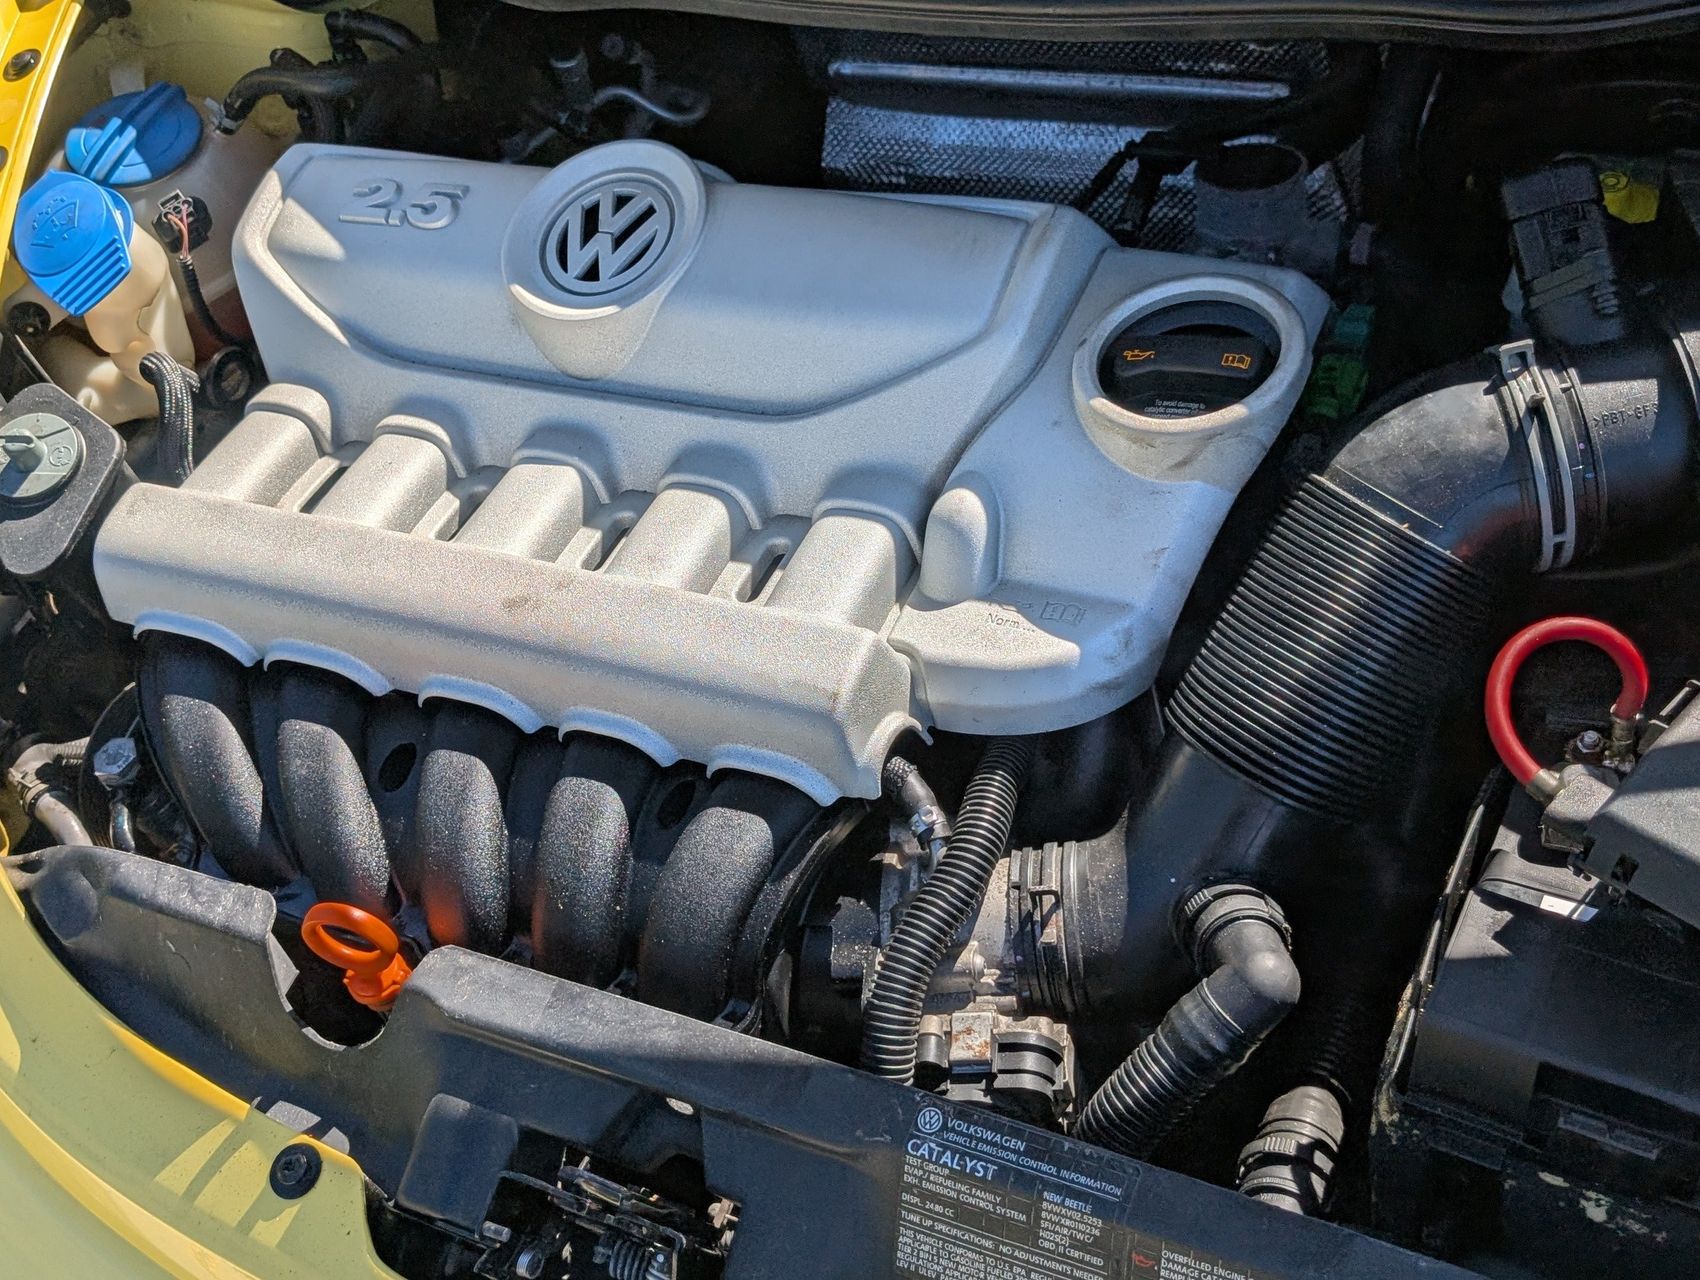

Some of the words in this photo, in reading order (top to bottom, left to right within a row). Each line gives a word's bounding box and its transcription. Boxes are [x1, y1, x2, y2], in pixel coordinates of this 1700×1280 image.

[338, 177, 471, 230] 2.5
[1178, 401, 1200, 409] damage
[947, 1118, 1026, 1152] VOLKSWAGEN
[905, 1155, 922, 1167] TEST
[923, 1161, 950, 1176] GROUP
[907, 1139, 998, 1180] CATALYST
[943, 1131, 977, 1148] VEHICLE
[977, 1142, 1018, 1162] EMISSION
[1019, 1156, 1058, 1175] CONTROL
[1060, 1169, 1122, 1196] INFORMATION
[904, 1174, 920, 1186] EXH.
[922, 1181, 958, 1199] EMISSION
[959, 1193, 994, 1212] CONTROL
[995, 1205, 1027, 1222] SYSTEM
[930, 1173, 970, 1193] REFUELING
[971, 1188, 1002, 1204] FAMILY
[1043, 1191, 1064, 1203] NEW
[1064, 1198, 1093, 1214] BEETLE
[901, 1192, 924, 1206] DISPL.
[925, 1201, 944, 1213] 2480
[944, 1208, 955, 1217] CC
[898, 1243, 911, 1254] TIER
[898, 1236, 937, 1255] APPLICABLE
[939, 1249, 949, 1258] TO
[950, 1252, 985, 1271] GASOLINE
[899, 1226, 915, 1238] THIS
[915, 1233, 942, 1248] VEHICLE
[944, 1243, 984, 1262] CONFORMS
[985, 1256, 996, 1266] TO
[901, 1210, 921, 1224] TUNE
[922, 1218, 933, 1227] UP
[934, 1222, 995, 1249] SPECIFICATIONS:
[999, 1244, 1012, 1255] NO
[1013, 1250, 1072, 1275] ADJUSTMENTS
[1038, 1240, 1055, 1250] OBD
[1065, 1248, 1104, 1266] CERTIFIED
[1161, 1250, 1212, 1271] OVERFILLED
[1161, 1258, 1200, 1278] DAMAGE
